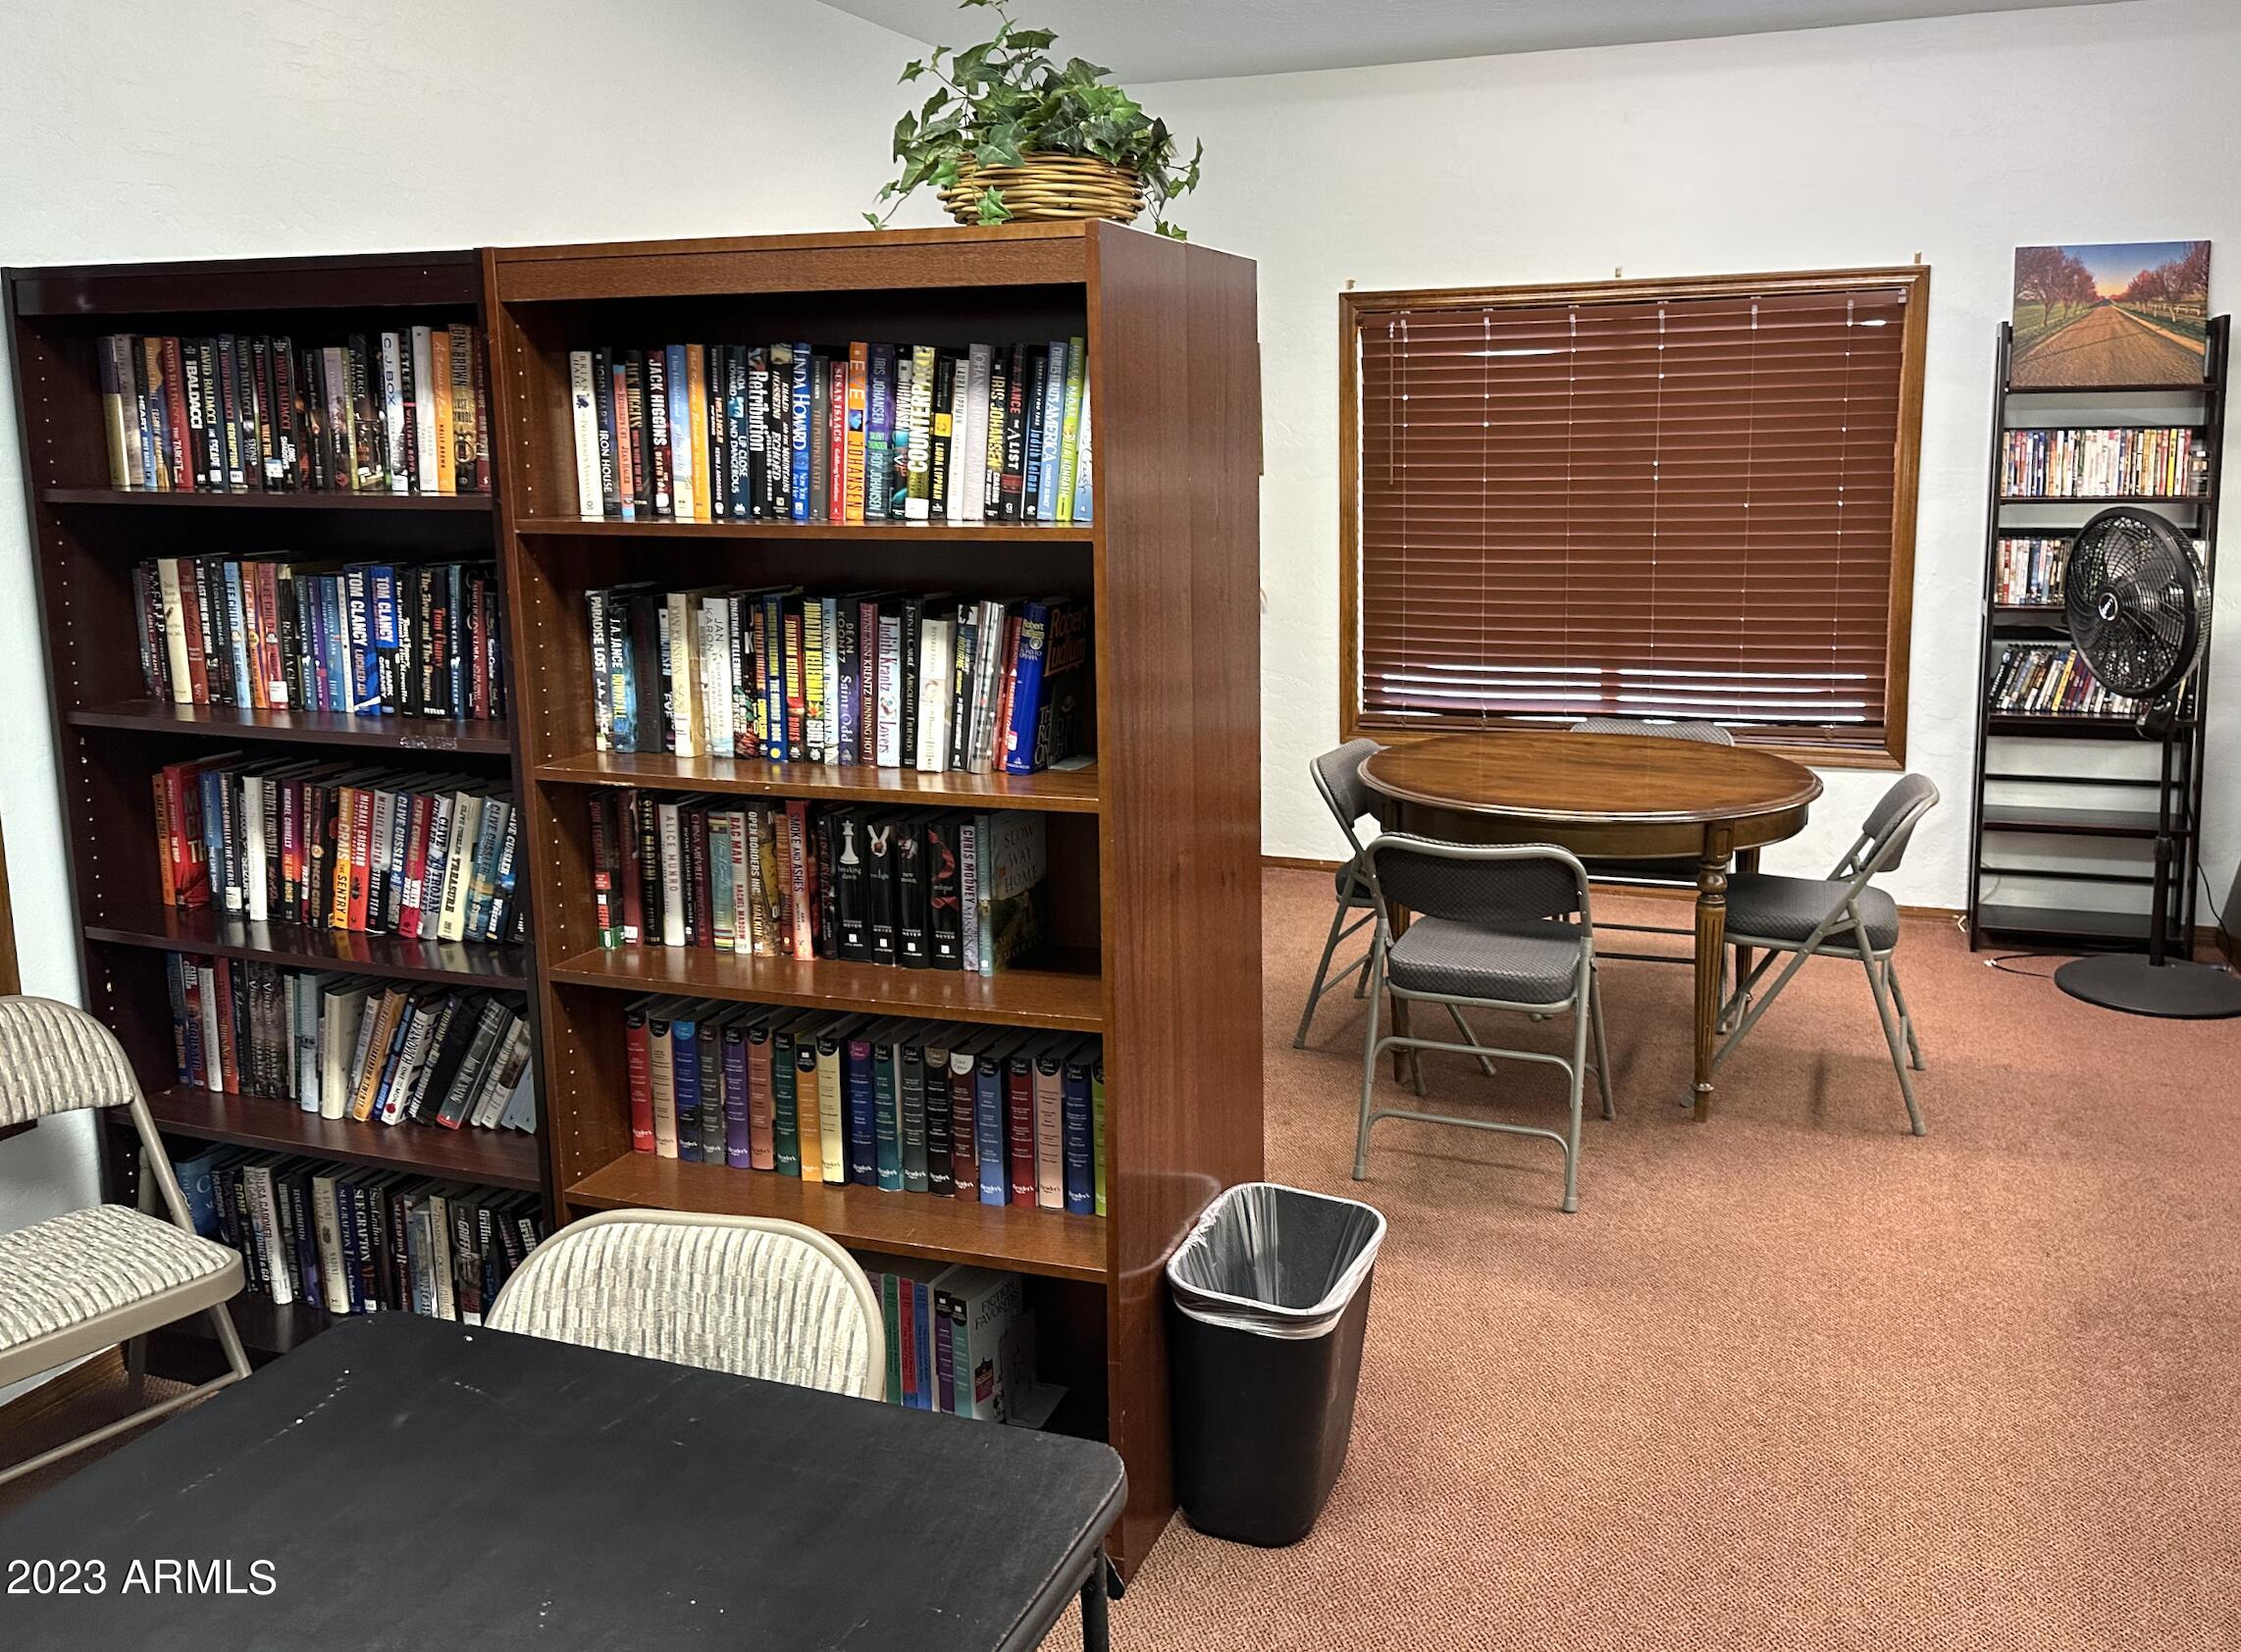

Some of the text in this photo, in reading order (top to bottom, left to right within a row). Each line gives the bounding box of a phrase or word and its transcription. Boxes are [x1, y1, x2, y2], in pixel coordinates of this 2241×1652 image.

[237, 340, 253, 415] DAVID BALDACCI
[451, 329, 467, 386] DAN BROWN
[957, 366, 965, 388] LAURA
[972, 352, 986, 401] JOHANNA
[186, 366, 202, 429] BALDACCI
[201, 346, 220, 467] DAVID BALDACCI ESCAPE
[277, 356, 290, 430] DAVID BALDACCI
[649, 359, 667, 446] JACK HIGGINS
[749, 371, 769, 451] Retribution
[793, 349, 810, 450] LINDA HOWARD
[833, 368, 842, 442] SUSAN ISAACS
[1010, 381, 1021, 414] JANCE
[227, 423, 238, 468] REDEMPTION
[739, 436, 746, 447] UP
[869, 358, 884, 510] IRIS JOHANSEN ROY JOHANSEN
[987, 376, 1005, 468] IRIS JOHANSEN
[1029, 429, 1043, 458] Judith
[1043, 404, 1057, 462] AMERICA
[599, 430, 612, 492] IRON HOUSE
[730, 440, 740, 493] DANGEROUS
[847, 440, 863, 508] JOHANSEN
[933, 442, 944, 499] LAURA LIPPMAN
[1009, 441, 1019, 470] LIST
[197, 581, 206, 596] LAST
[226, 582, 237, 627] LEE CHILD
[348, 572, 363, 597] TOM
[377, 577, 393, 643] TOM CLANCY
[351, 600, 368, 646] CLANCY
[423, 621, 432, 641] and
[591, 596, 606, 673] PARADISE LOST
[714, 619, 724, 642] JAN
[730, 597, 742, 686] JONATHAN KELLERMAN
[355, 649, 365, 681] LOCKED
[611, 637, 626, 719] JANCE DOWNFALL
[804, 602, 823, 749] JONATHAN KELLERMAN GUILT
[863, 659, 872, 696] KRENTZ
[879, 622, 897, 752] Judith Krantz Lovers
[789, 717, 800, 741] BONES
[840, 675, 853, 743] Saint Odd
[863, 738, 872, 753] HOT
[358, 795, 369, 827] MICHAEL
[392, 797, 407, 872] CLIVE CUSSLER
[410, 799, 423, 861] CLIVE CUSSLER
[437, 817, 447, 847] CLIVE
[482, 804, 500, 874] CLIVE CUSSLER
[790, 813, 801, 844] SMOKE
[337, 823, 349, 913] CRAIS SENTRY
[371, 869, 381, 889] STATE
[500, 836, 515, 875] CUSSLER
[666, 816, 678, 892] ALICE MUNRO
[732, 841, 742, 864] MAN
[749, 811, 762, 936] OPEN BORDERS MALKIN
[793, 863, 804, 893] ASHES
[963, 830, 975, 903] CHRIS MOONEY
[410, 879, 421, 908] WHITE
[428, 873, 442, 913] TROJAN
[445, 856, 460, 912] TREASURE
[353, 1189, 371, 1262] SUE GRAFTON
[458, 1220, 471, 1258] GRIFFIN
